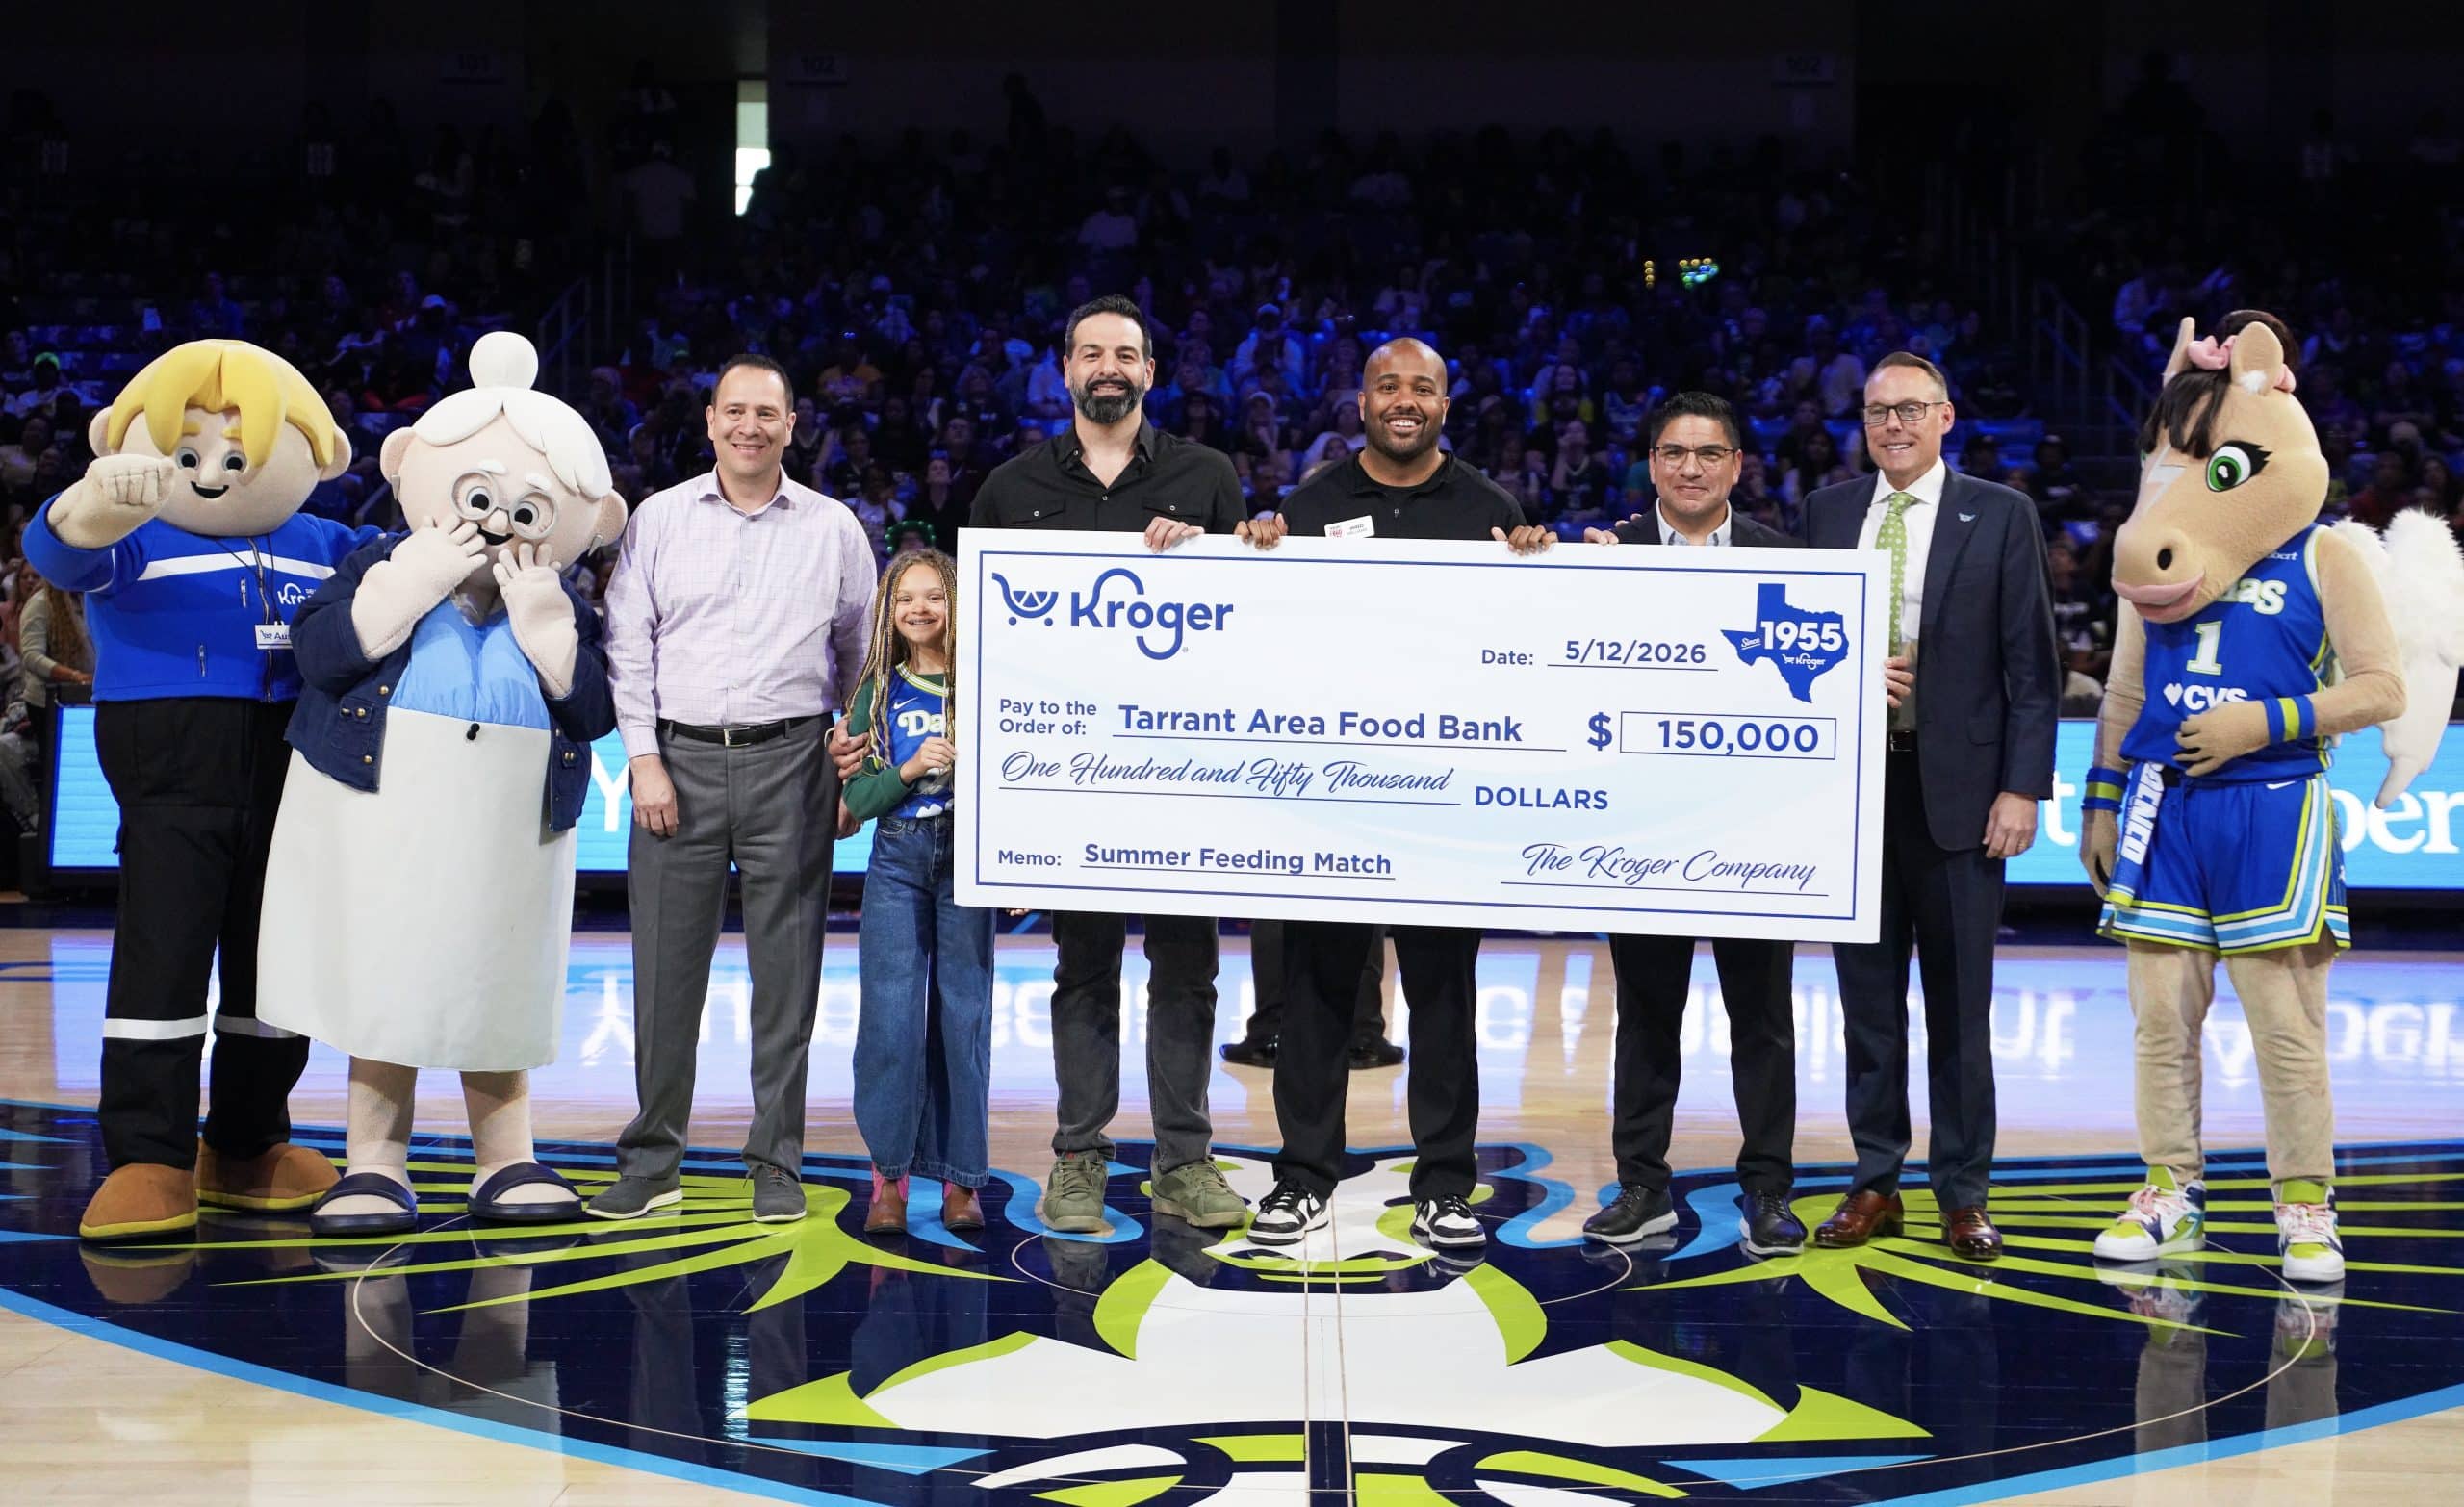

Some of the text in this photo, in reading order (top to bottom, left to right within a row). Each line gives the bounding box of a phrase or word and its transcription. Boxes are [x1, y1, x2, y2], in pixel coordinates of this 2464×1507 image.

[1070, 568, 1234, 660] Kroger
[1481, 639, 1707, 666] Date: 5/12/2026
[1760, 621, 1843, 651] 1955
[2186, 621, 2223, 676] 1
[1796, 653, 1827, 670] Kroger
[999, 699, 1097, 717] Pay to the
[1118, 704, 1523, 741] Tarrant Area Food Bank
[999, 718, 1087, 735] Order of:
[1587, 712, 1819, 755] $ 150,000
[1001, 751, 1609, 810] One Hundred and Fifty Thousand DOLLARS
[998, 843, 1392, 874] Memo: Summer Feeding Match
[1522, 843, 1817, 892] The Kroger Company
